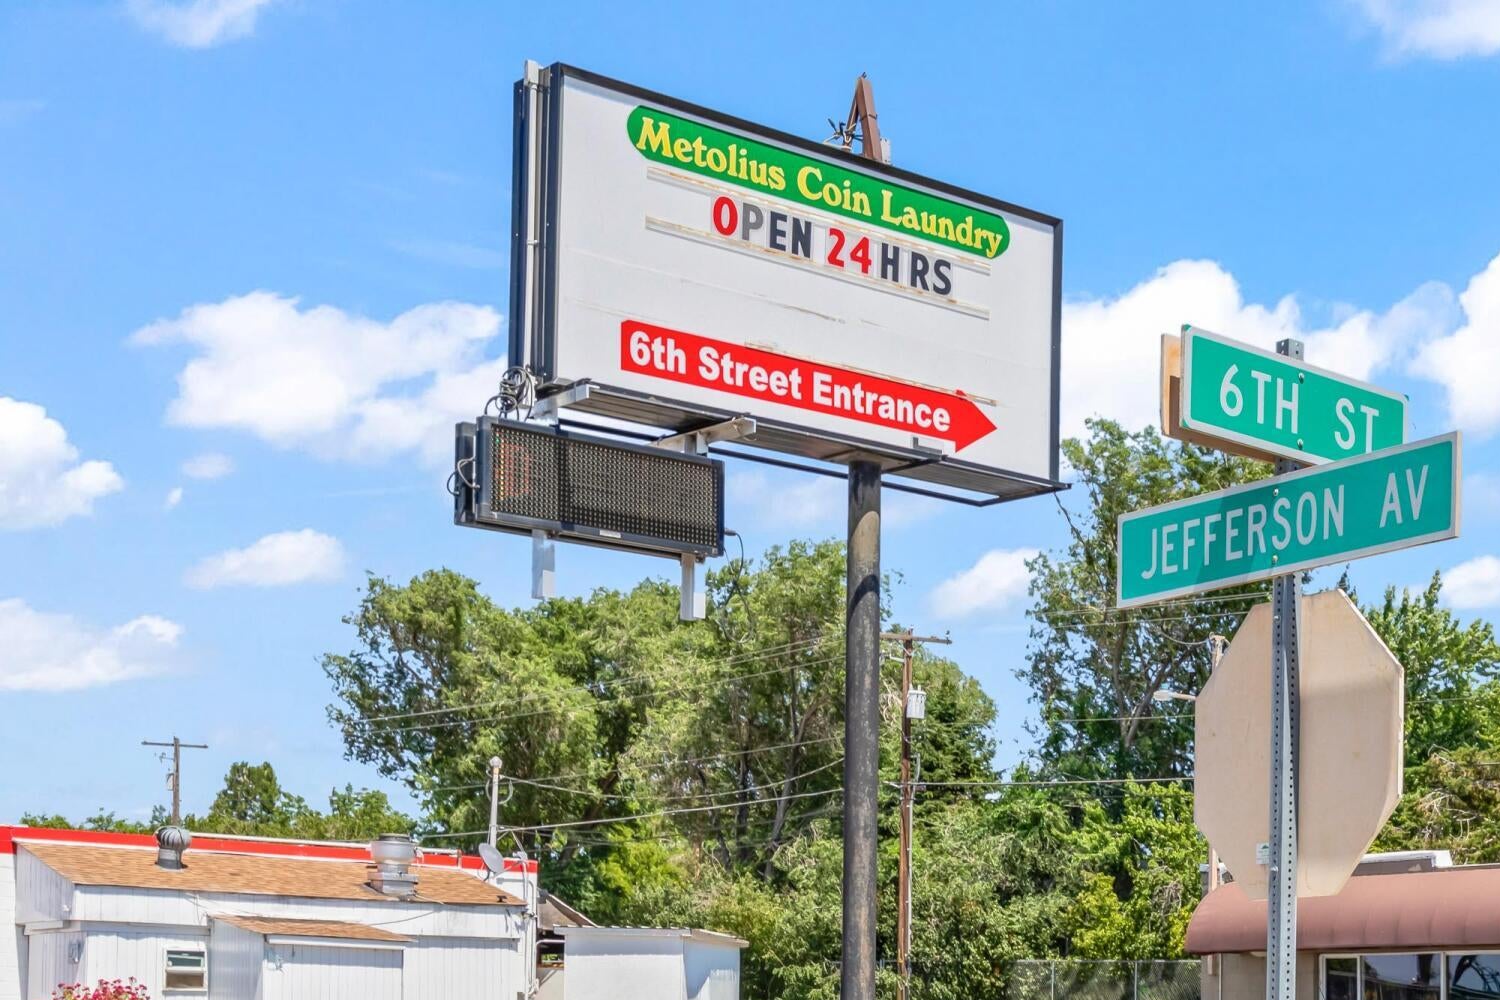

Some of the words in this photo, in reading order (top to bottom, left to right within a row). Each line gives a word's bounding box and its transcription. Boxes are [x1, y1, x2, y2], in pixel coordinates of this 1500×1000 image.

[636, 116, 786, 190] Metolius
[797, 166, 872, 217] Coin
[880, 190, 1003, 258] Laundry
[712, 196, 812, 259] OPEN
[629, 331, 687, 374] 6th
[698, 346, 802, 400] Street
[812, 371, 951, 432] Entrance
[1219, 364, 1299, 434] 6TH
[1334, 398, 1379, 454] ST
[1141, 484, 1345, 580] JEFFERSON
[1379, 464, 1430, 528] AV
